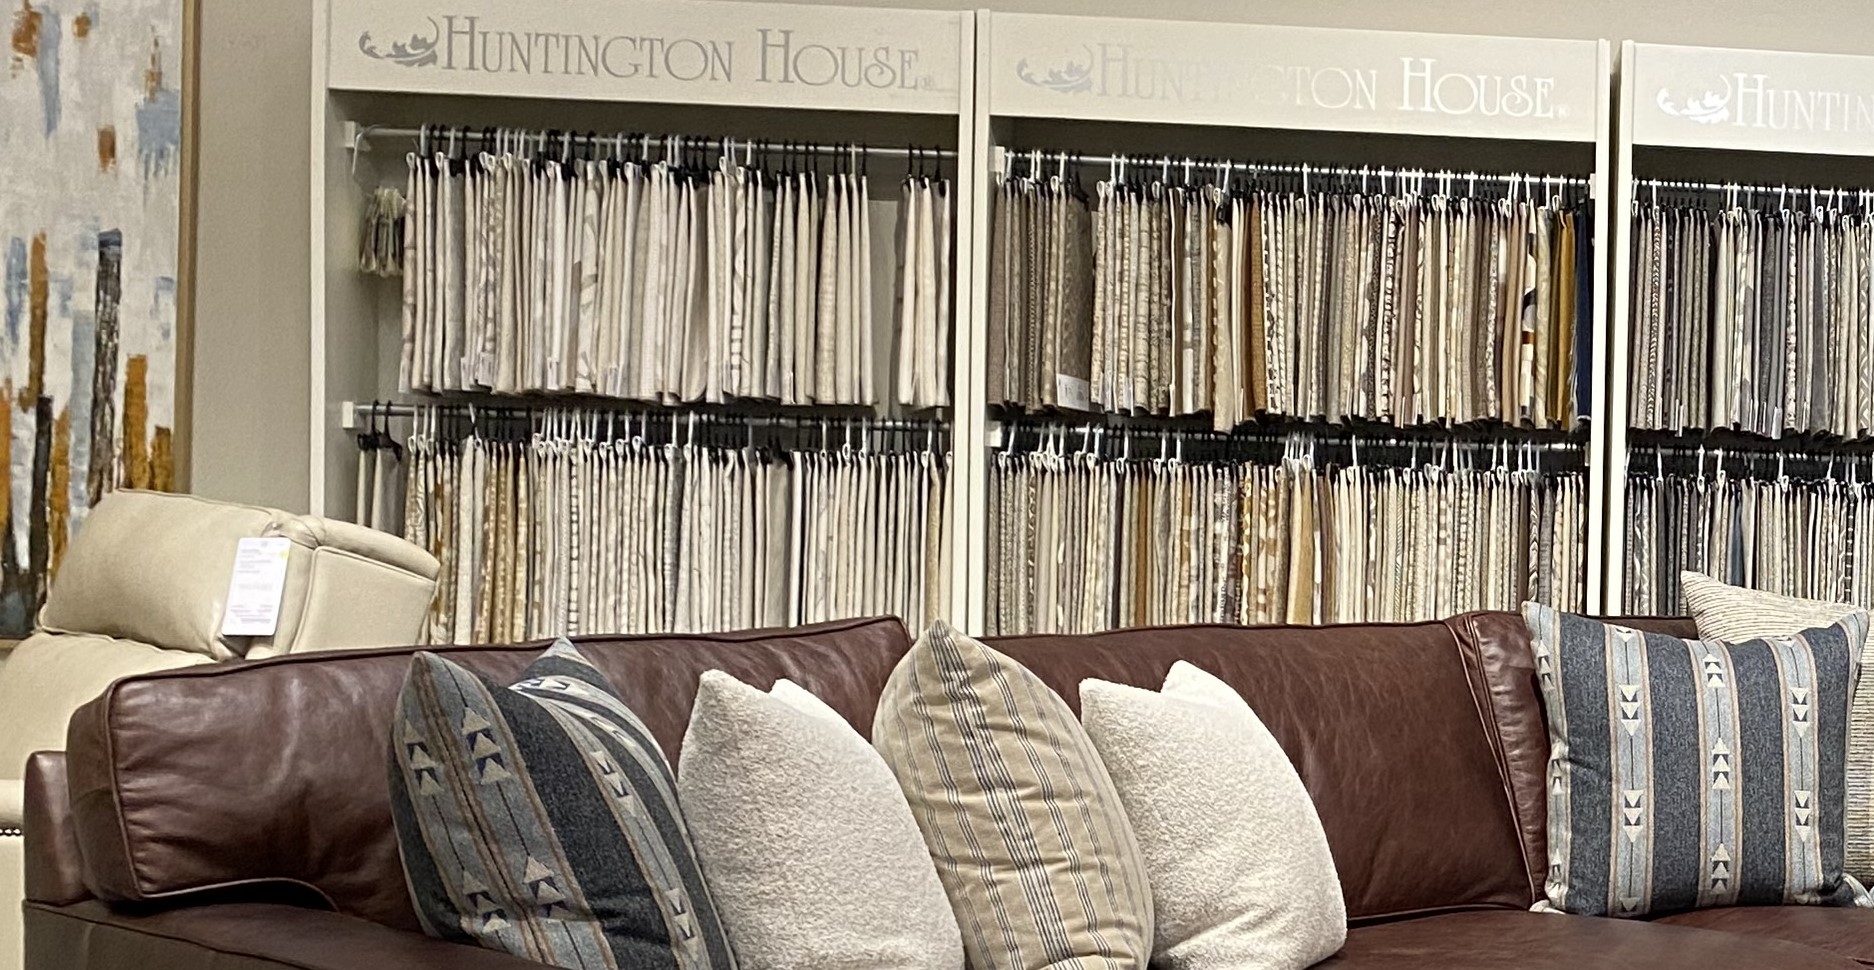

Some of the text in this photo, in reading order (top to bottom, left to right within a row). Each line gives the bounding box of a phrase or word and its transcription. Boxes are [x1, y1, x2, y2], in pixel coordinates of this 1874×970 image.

[441, 15, 919, 91] HUNTINGTON HOUSE
[1096, 42, 1555, 119] HUNTGTON HOUSE
